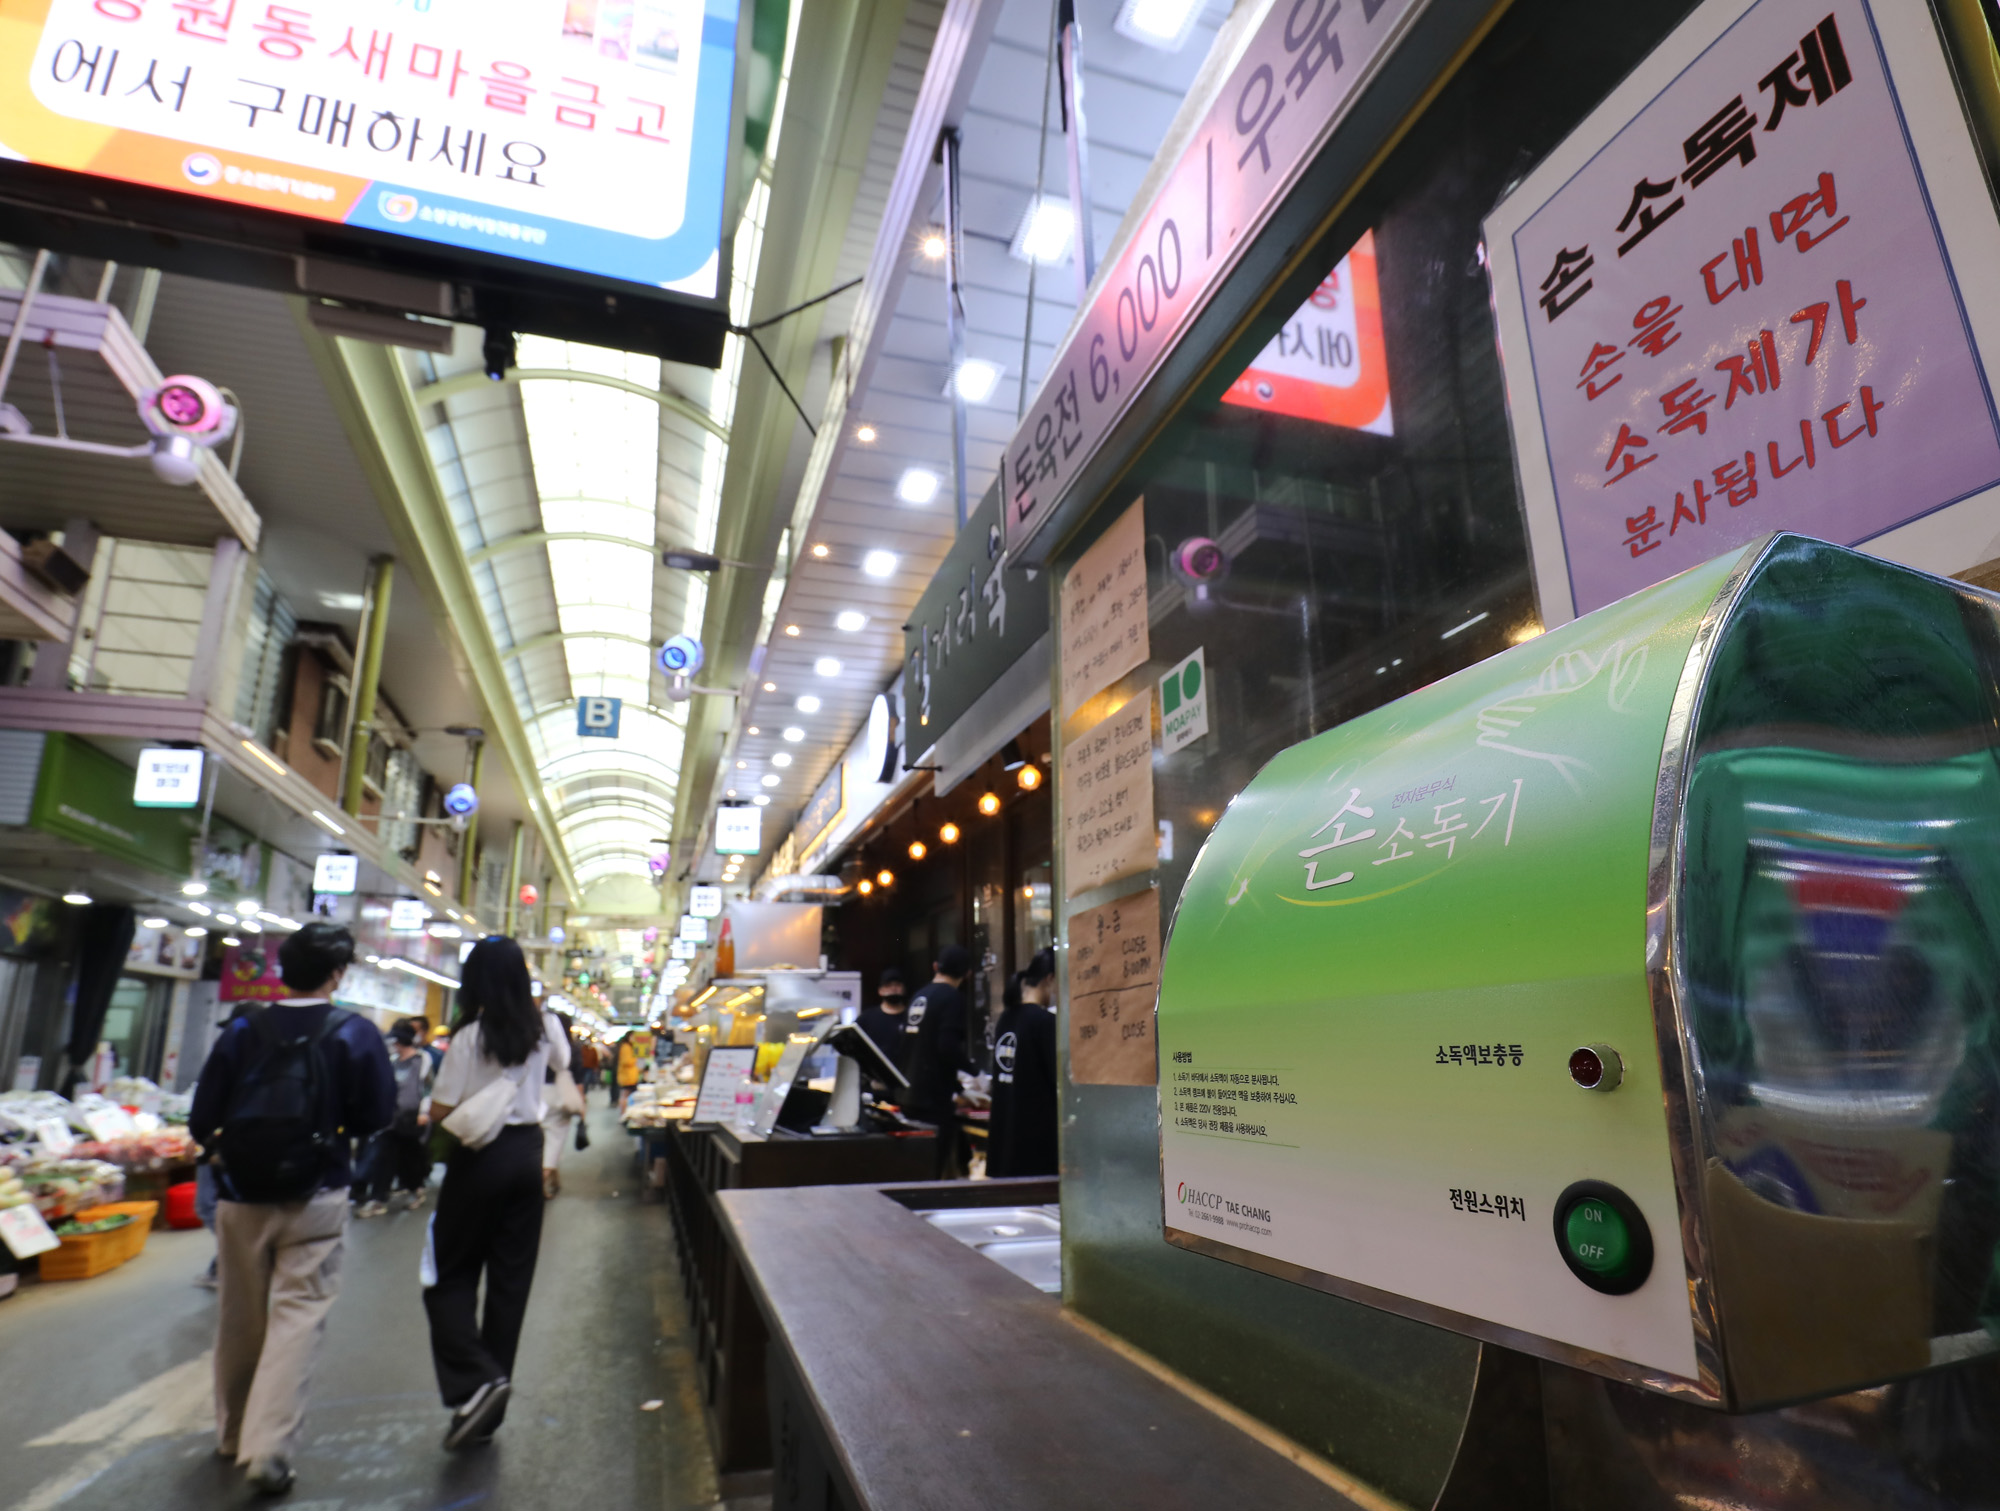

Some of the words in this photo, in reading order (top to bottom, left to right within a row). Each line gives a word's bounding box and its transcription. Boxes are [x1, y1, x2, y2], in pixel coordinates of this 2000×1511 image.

[51, 39, 192, 112] 에서
[229, 78, 548, 188] 구매하세요
[1538, 243, 1595, 323] 손
[1615, 12, 1853, 259] 소독제
[1014, 370, 1083, 523] 돈육전
[1089, 218, 1183, 403] 6,000
[1236, 0, 1386, 174] 우육
[1576, 295, 1685, 401] 손을
[1700, 171, 1850, 304] 대면
[1603, 279, 1867, 489] 소독제가
[1622, 385, 1885, 558] 분사됩니다
[585, 698, 613, 728] B
[1165, 702, 1202, 737] MOAPAY
[1391, 774, 1457, 809] 전자분무식
[1298, 787, 1377, 891] 손
[1371, 778, 1524, 867] 소독기
[1122, 935, 1146, 955] CLOSE
[1122, 1020, 1146, 1040] CLOSE
[1172, 1051, 1192, 1063] 사용방법
[1435, 1044, 1524, 1067] 소독액보충등
[1230, 1074, 1250, 1085] 자동으로
[1251, 1075, 1280, 1086] 분사됩니다.
[1185, 1103, 1198, 1113] 제품은
[1199, 1104, 1211, 1114] 220V
[1212, 1104, 1237, 1117] 전용입니다.
[1217, 1089, 1237, 1101] 들어오면
[1250, 1091, 1271, 1103] 보충하여
[1273, 1092, 1298, 1104] 주십시오.
[1219, 1121, 1234, 1133] 제품을
[1235, 1123, 1267, 1137] 사용하십시오.
[1187, 1188, 1222, 1210] HACCP
[1225, 1200, 1240, 1215] TAE
[1241, 1204, 1271, 1222] CHANG
[1448, 1188, 1526, 1221] 전원스위치
[1584, 1207, 1603, 1223] ON
[1578, 1243, 1604, 1260] OFF
